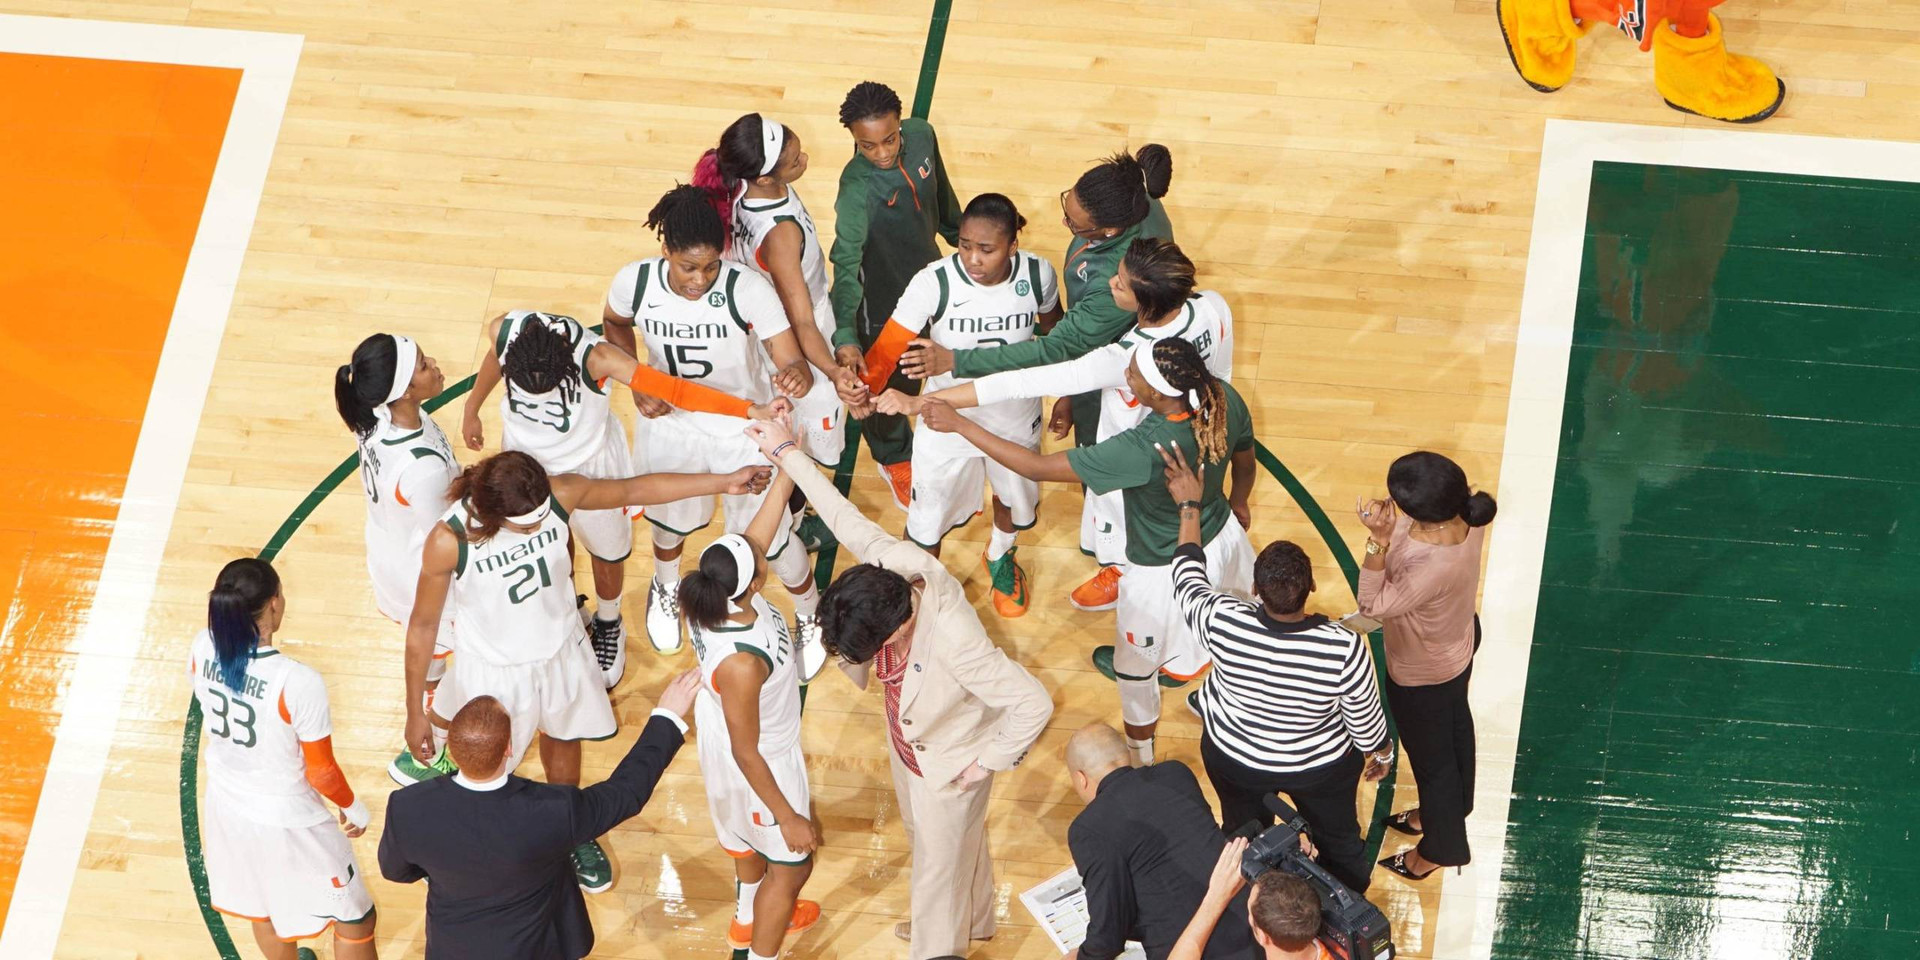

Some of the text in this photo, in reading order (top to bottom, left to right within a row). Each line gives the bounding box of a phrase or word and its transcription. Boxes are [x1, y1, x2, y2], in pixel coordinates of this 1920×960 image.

[711, 293, 725, 306] ES
[663, 343, 713, 379] 15
[502, 556, 552, 604] 21
[208, 687, 257, 748] 33
